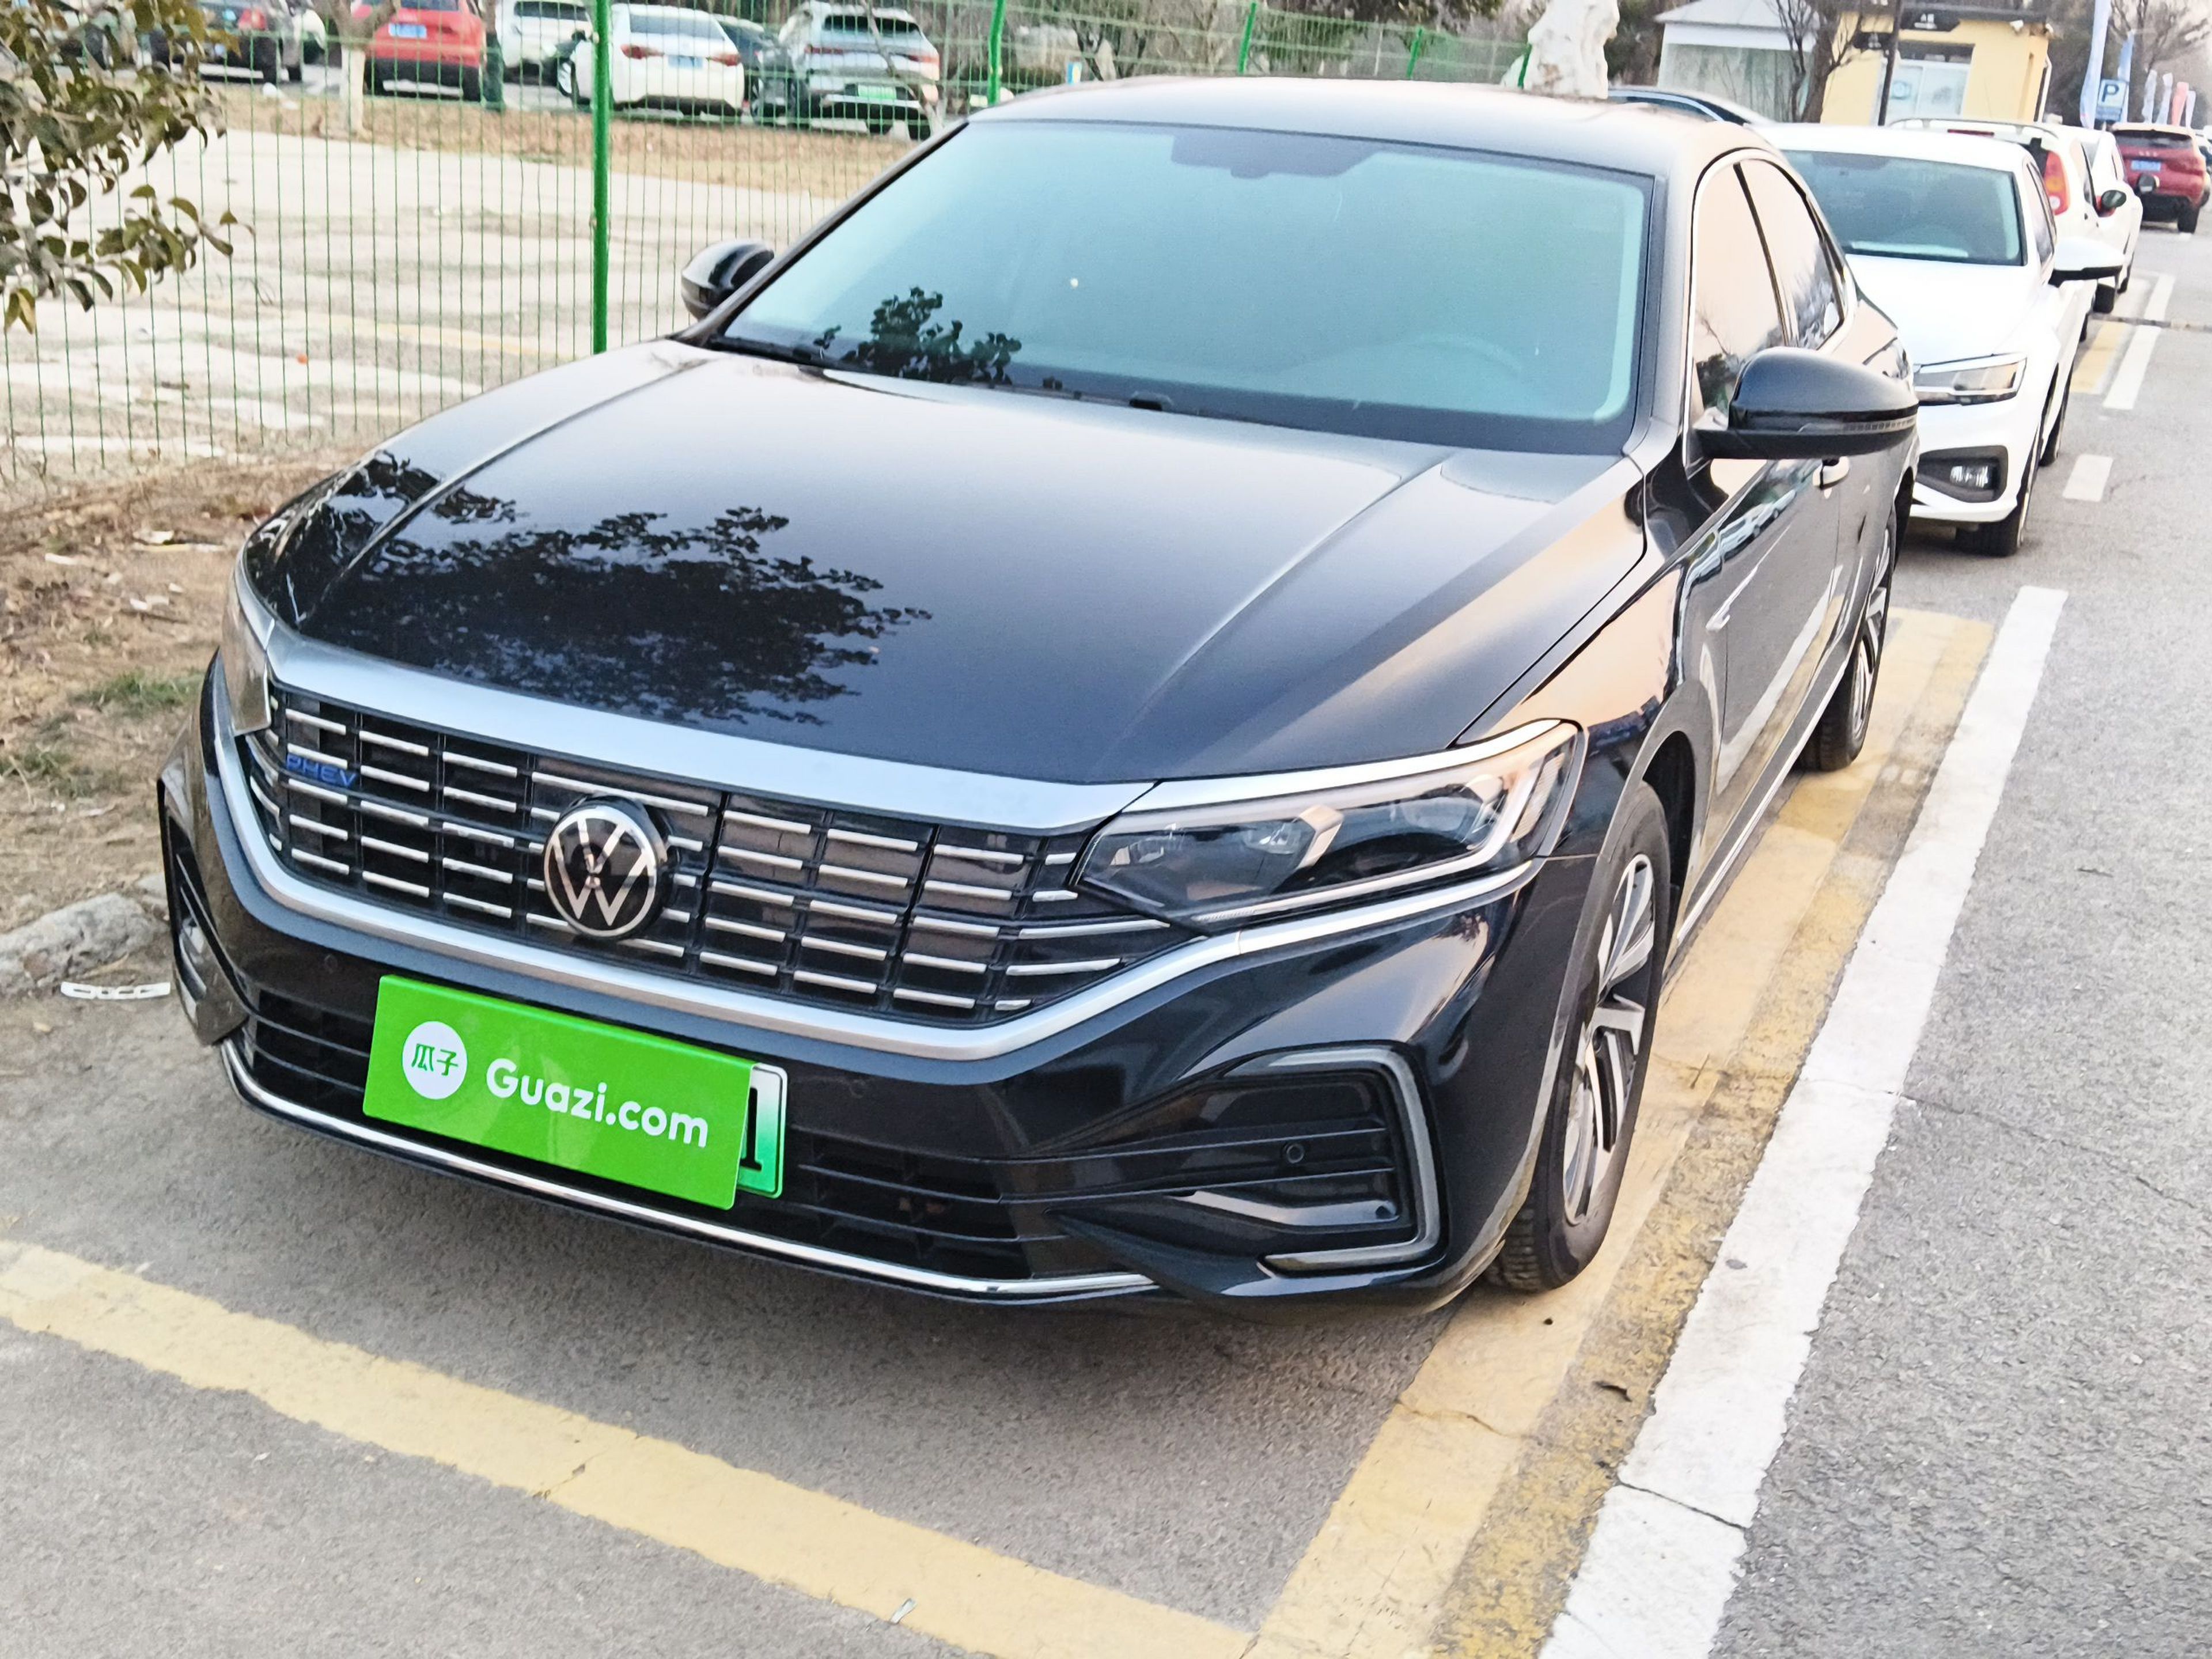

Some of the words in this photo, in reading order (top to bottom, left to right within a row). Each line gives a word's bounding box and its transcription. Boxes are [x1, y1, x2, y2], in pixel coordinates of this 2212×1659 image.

[2101, 84, 2119, 102] P
[286, 752, 357, 787] PHEV
[550, 813, 655, 929] VW
[411, 1043, 459, 1076] 瓜子
[486, 1058, 709, 1148] Guazi.com
